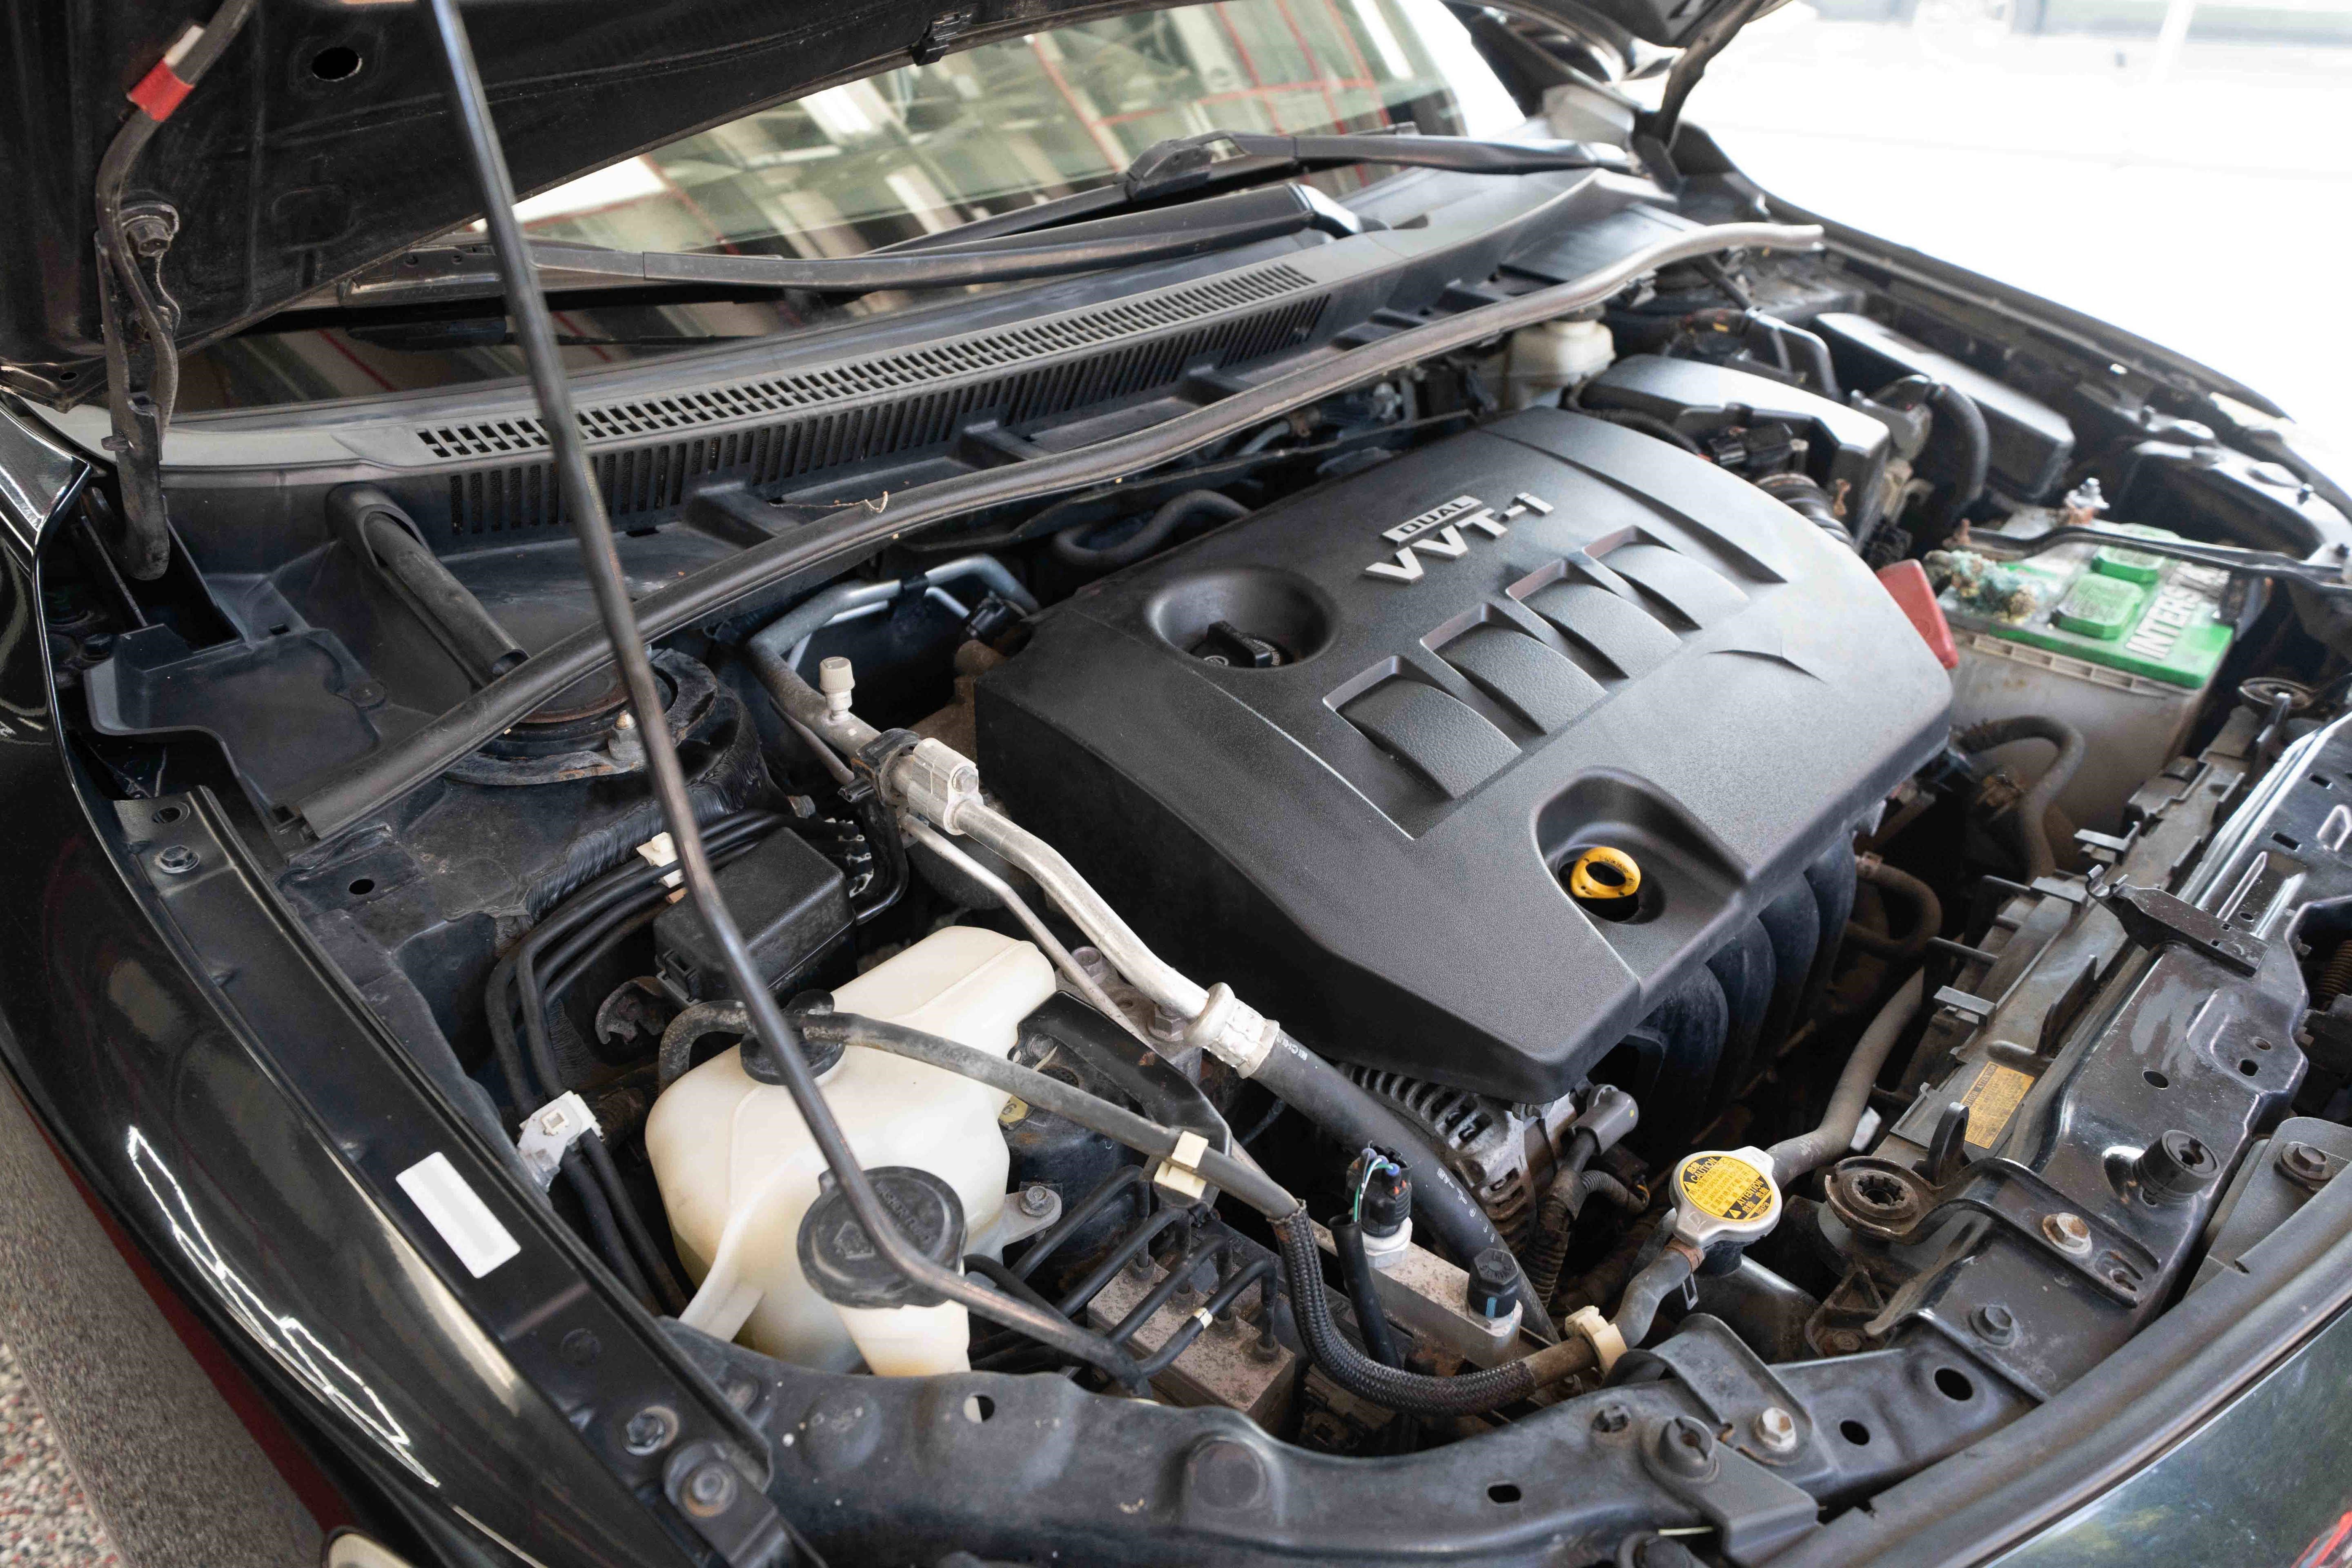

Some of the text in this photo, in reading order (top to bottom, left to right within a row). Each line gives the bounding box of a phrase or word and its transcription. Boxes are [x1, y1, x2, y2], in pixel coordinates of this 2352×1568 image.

[1396, 500, 1474, 535] DUAL
[1599, 855, 1629, 873] ENGINE
[1976, 1065, 1997, 1089] ATTENTION
[1690, 1157, 1717, 1181] CAUTION
[1740, 1179, 1764, 1205] ATTENTION
